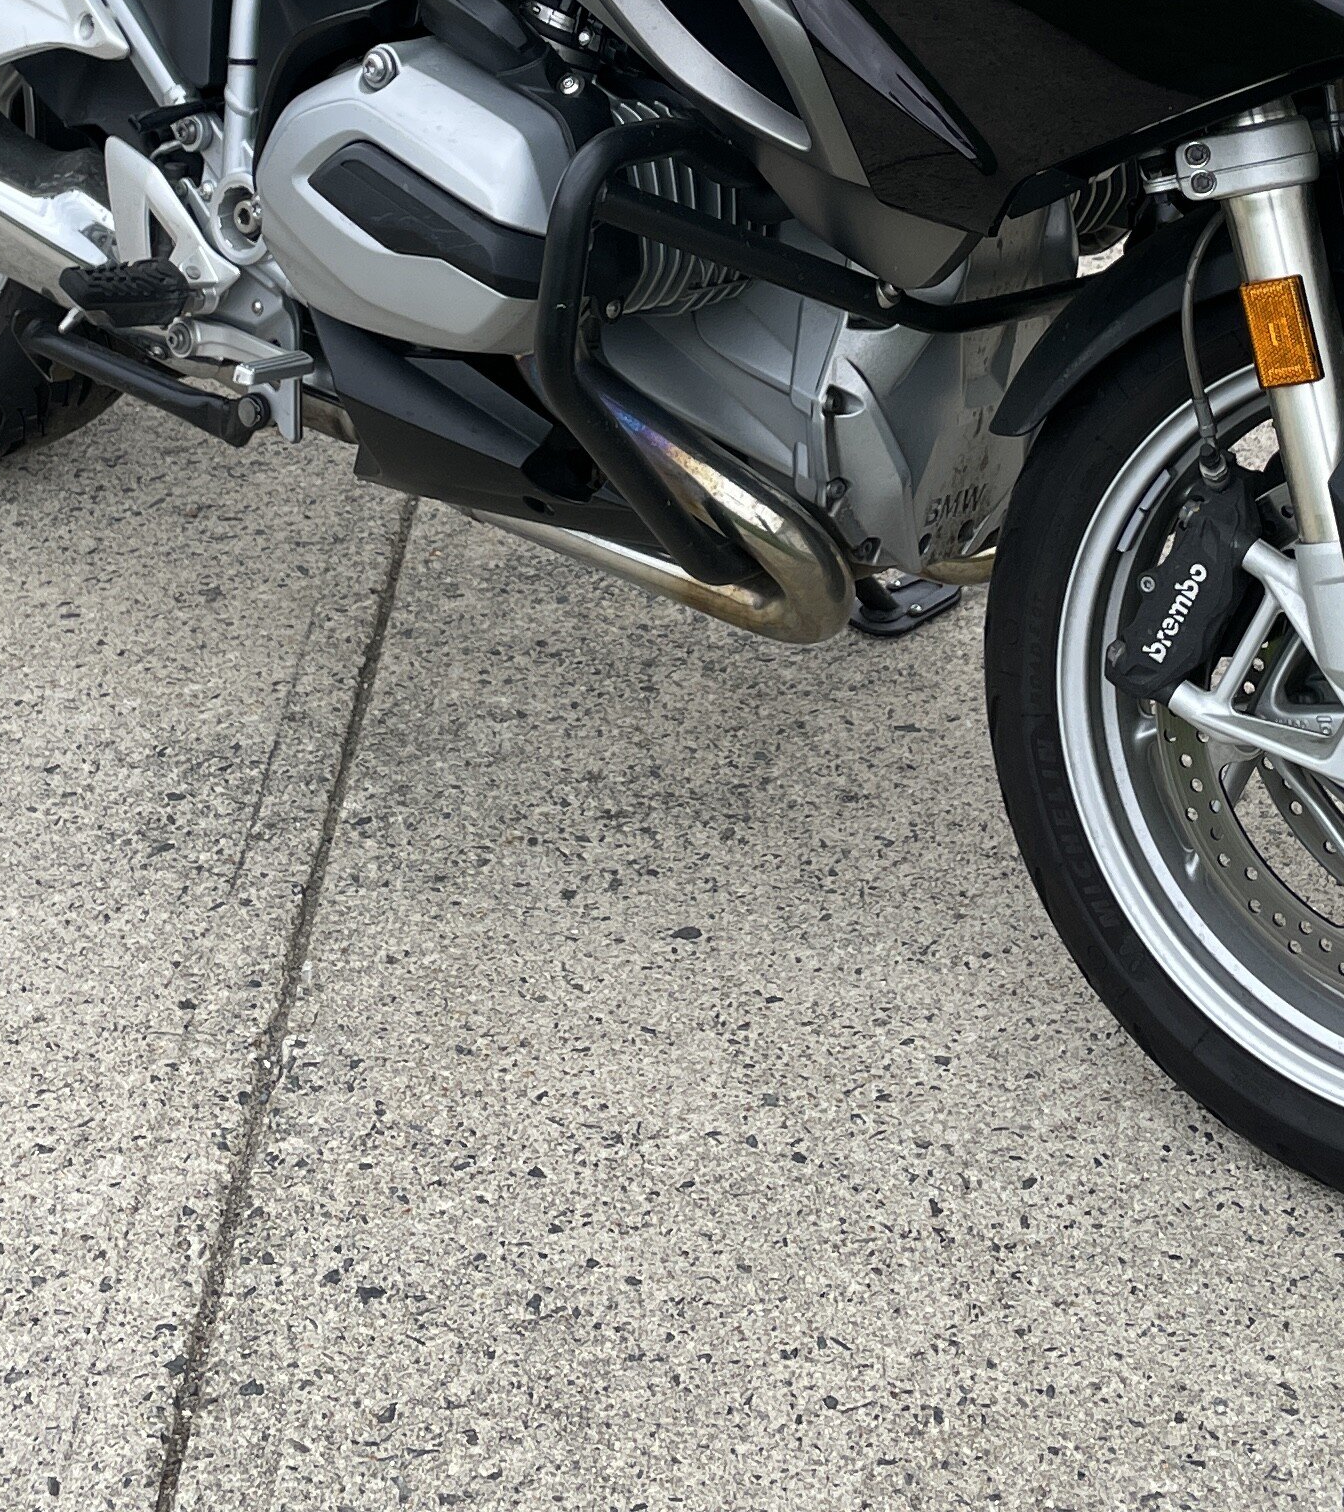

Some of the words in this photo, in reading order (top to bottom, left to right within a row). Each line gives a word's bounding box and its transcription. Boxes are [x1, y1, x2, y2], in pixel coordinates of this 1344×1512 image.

[924, 486, 988, 529] BMW
[1142, 563, 1208, 664] brembo
[1036, 736, 1121, 929] MICHELIN
